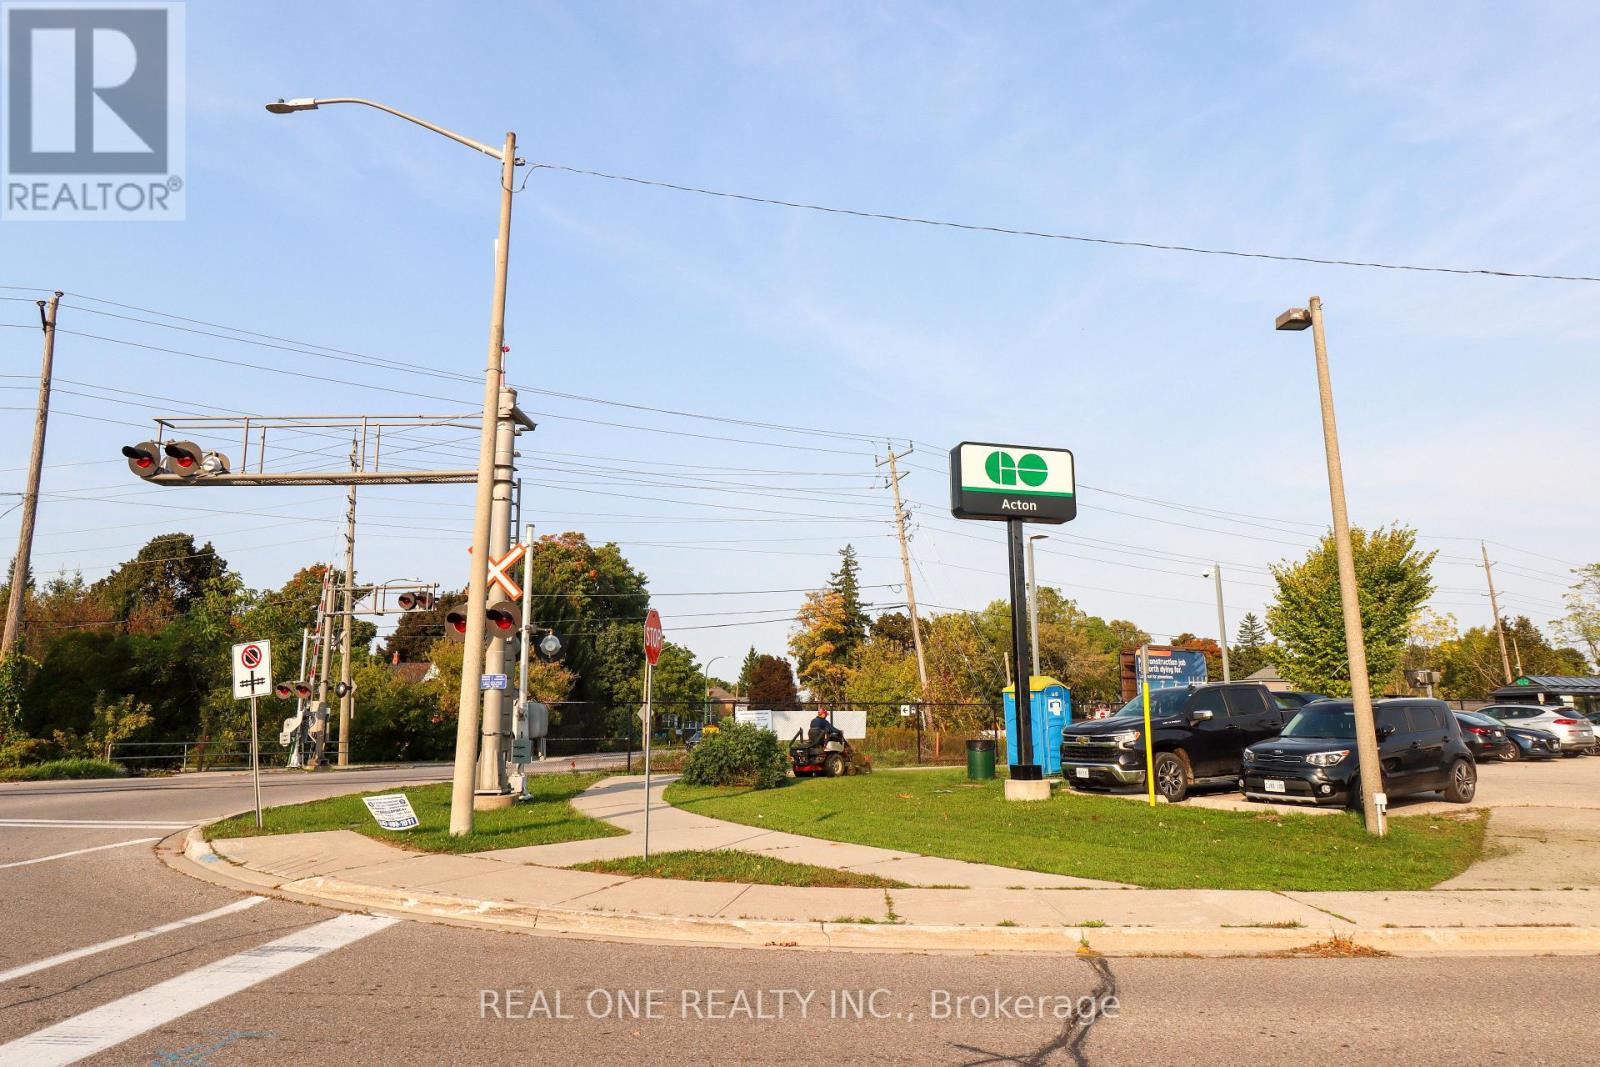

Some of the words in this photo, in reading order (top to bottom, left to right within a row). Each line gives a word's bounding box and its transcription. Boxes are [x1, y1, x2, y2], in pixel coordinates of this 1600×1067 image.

[985, 451, 1048, 487] GO
[1001, 499, 1037, 511] Acton
[646, 627, 661, 647] STOP
